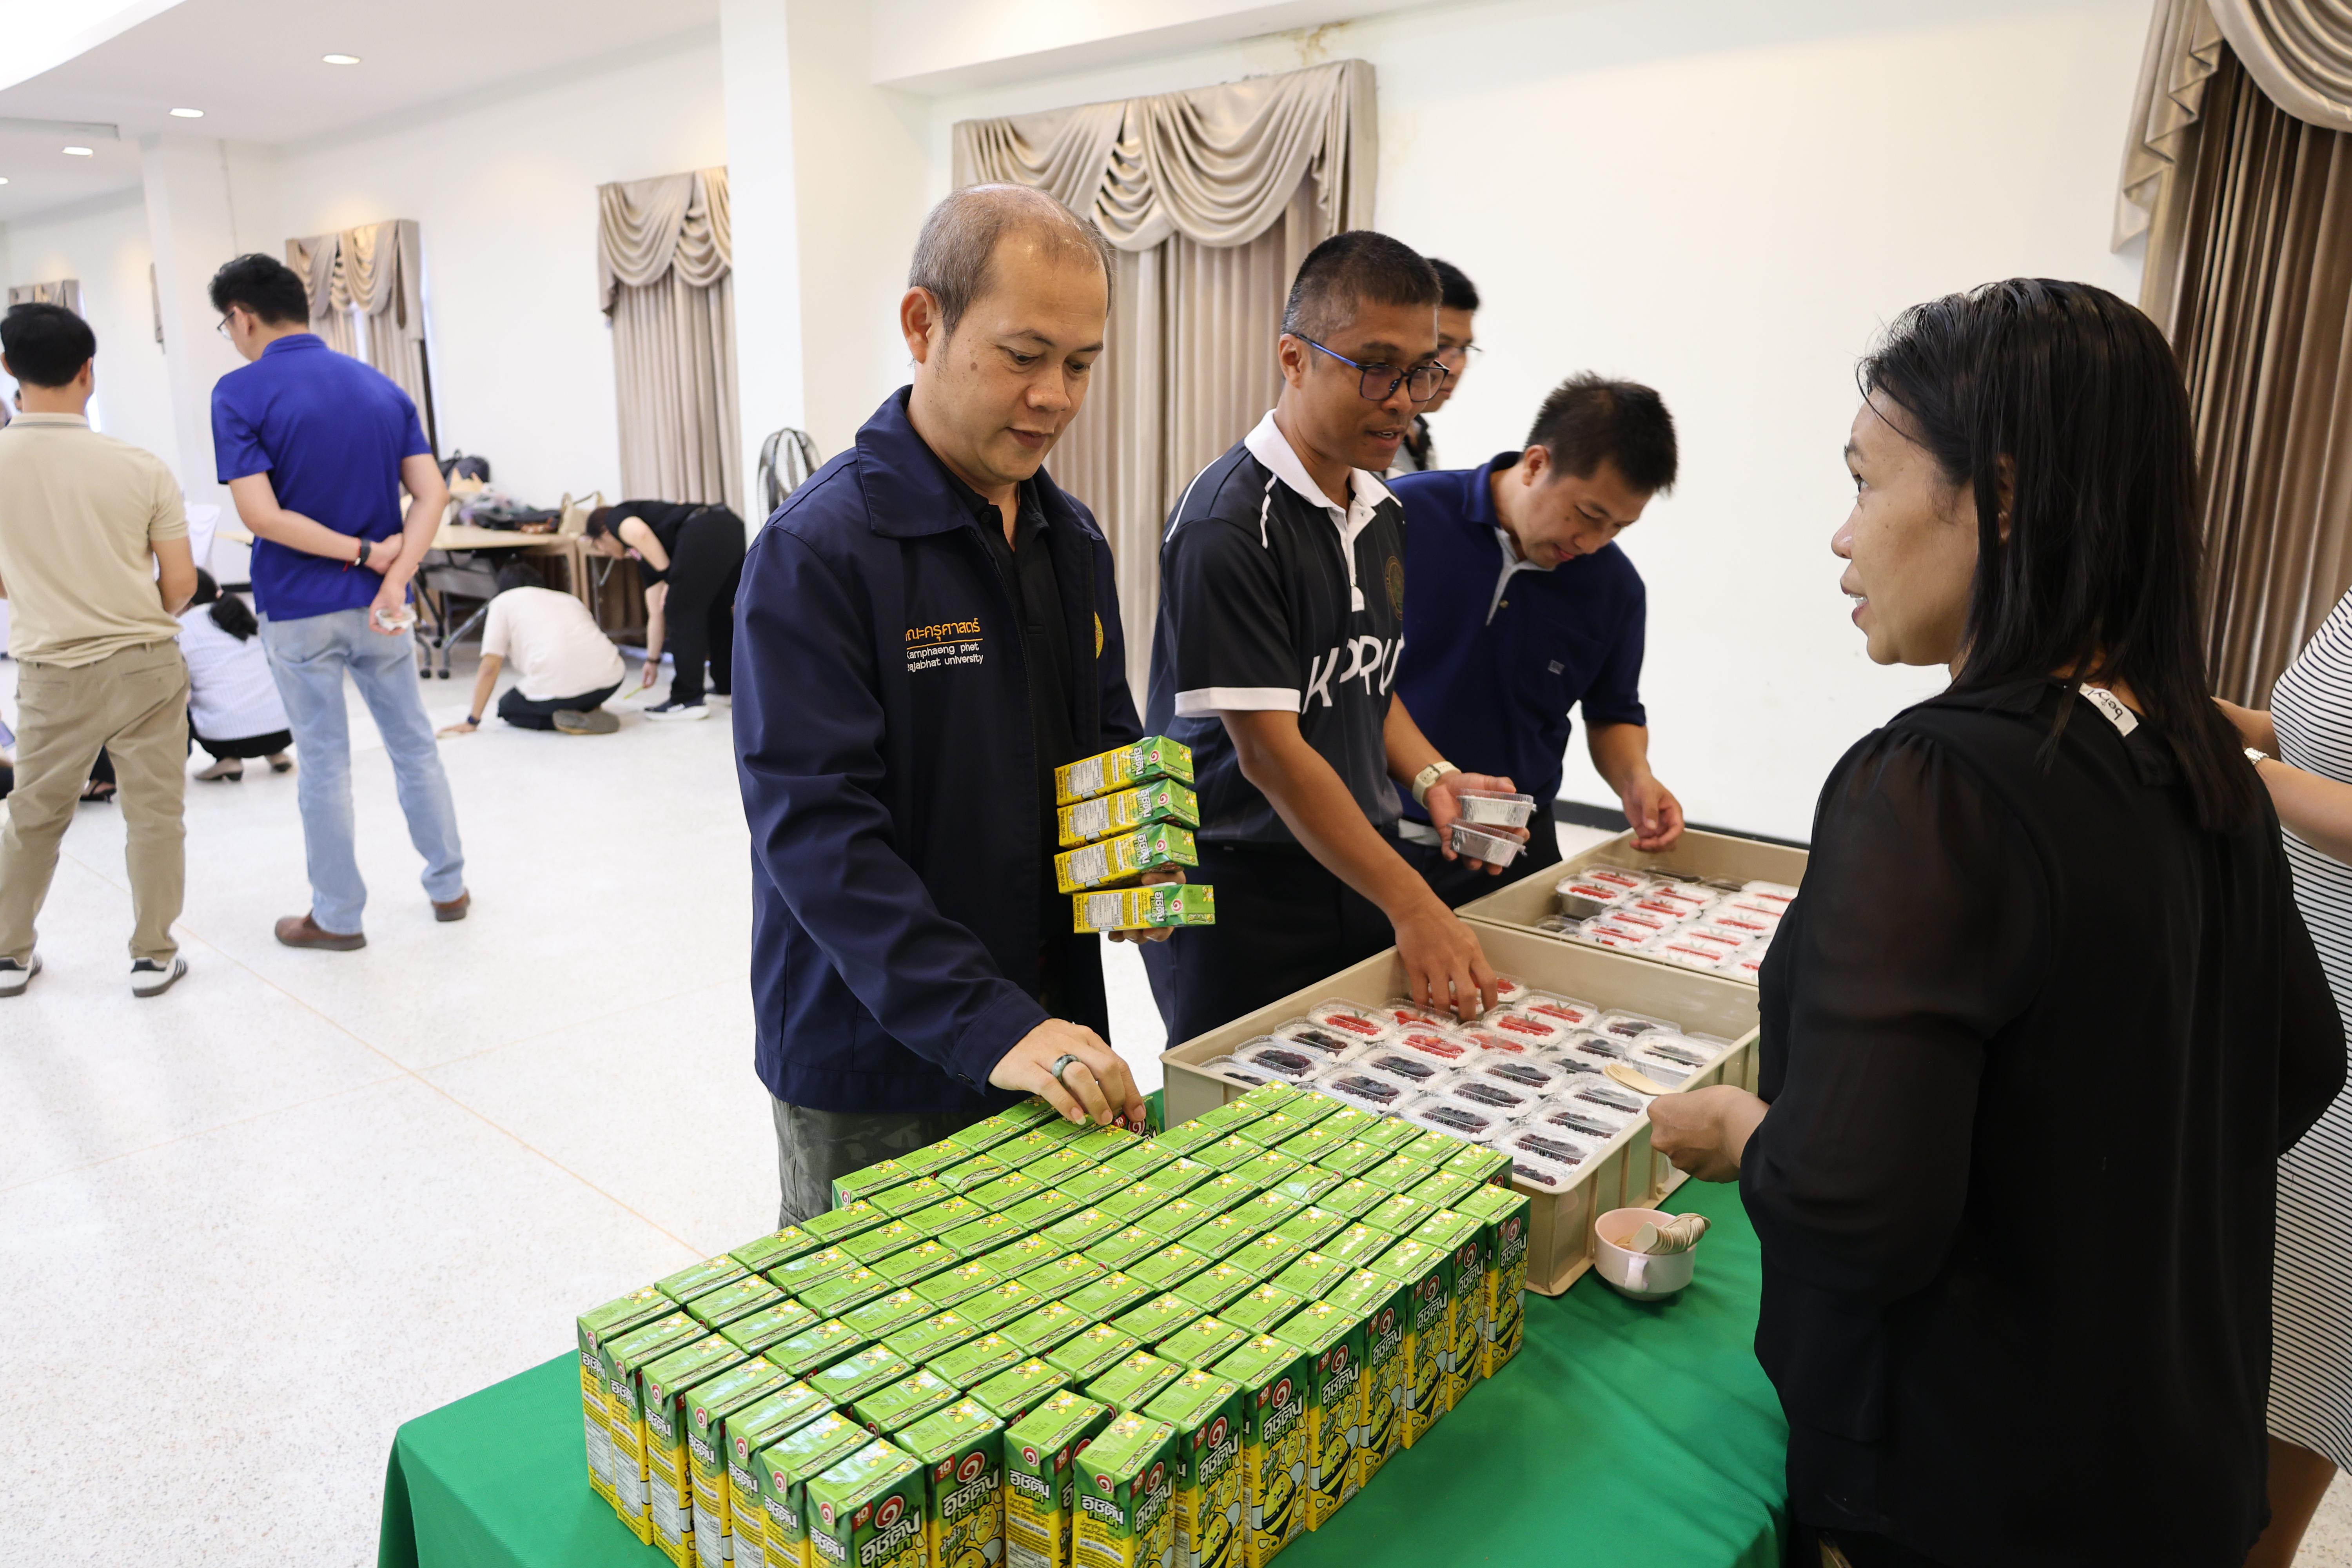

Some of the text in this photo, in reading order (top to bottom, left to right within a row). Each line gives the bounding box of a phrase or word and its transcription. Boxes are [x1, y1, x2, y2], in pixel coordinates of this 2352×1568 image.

[906, 617, 980, 641] ณะครุศาสตร์
[961, 642, 979, 654] phet
[945, 654, 984, 665] university
[1115, 1117, 1123, 1125] 10
[1500, 1222, 1506, 1233] 10
[1456, 1248, 1462, 1259] 10
[1501, 1234, 1527, 1267] อิชิตัน
[1458, 1258, 1483, 1294] อิชิตัน
[1416, 1283, 1423, 1294] 10
[1417, 1293, 1447, 1329] อิชิตัน
[1371, 1318, 1377, 1330] 10
[1373, 1328, 1402, 1366] อิชิตัน
[1321, 1352, 1329, 1366] 10
[1323, 1361, 1359, 1403] อิชิตัน
[1259, 1387, 1269, 1401] 10
[1263, 1396, 1303, 1443] อิชิตัน
[1196, 1427, 1205, 1442] 10
[1200, 1433, 1239, 1483] อิชิตัน
[938, 1459, 951, 1474] 10
[1133, 1472, 1143, 1489] 10
[944, 1468, 1000, 1517] อิชิตัน
[1136, 1477, 1172, 1533] อิชิตัน
[855, 1508, 867, 1522] 10
[861, 1510, 920, 1562] อิชิตัน
